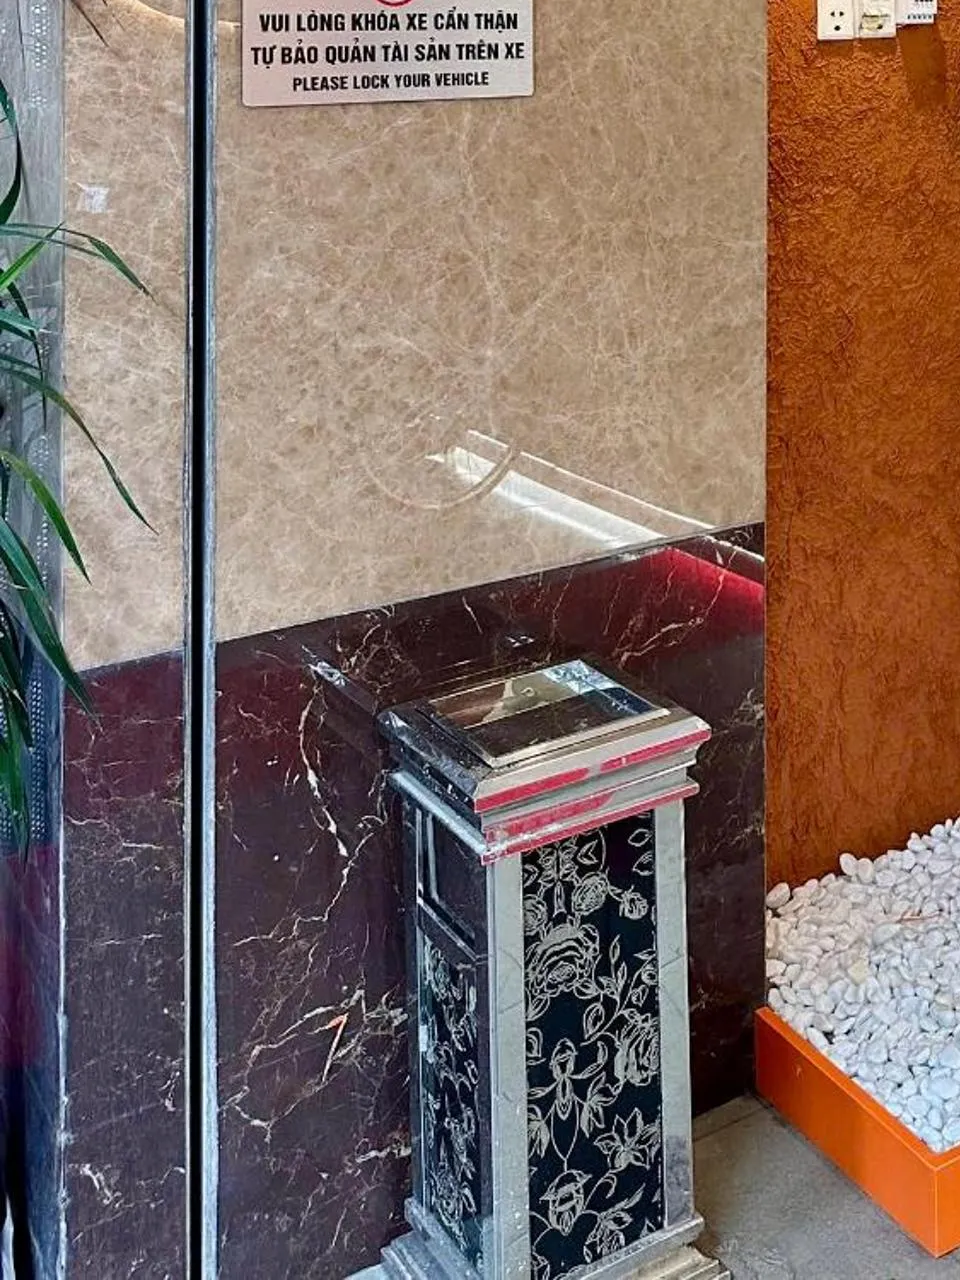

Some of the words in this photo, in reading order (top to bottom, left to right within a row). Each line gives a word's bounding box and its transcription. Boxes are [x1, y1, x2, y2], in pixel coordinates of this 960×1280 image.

[259, 14, 290, 33] VUI
[296, 10, 345, 33] LÒNG
[406, 14, 427, 30] XE
[434, 6, 469, 30] CẨN
[251, 46, 277, 70] TỰ
[282, 39, 318, 64] BẢO
[325, 37, 376, 64] QUẢN
[382, 43, 409, 63] TÀI
[414, 37, 450, 62] SẢN
[456, 40, 499, 60] TRÊN
[504, 42, 525, 59] XE
[293, 76, 349, 91] PLEASE
[353, 75, 390, 89] LOCK
[395, 73, 430, 88] YOUR
[435, 71, 489, 87] VEHICLE
